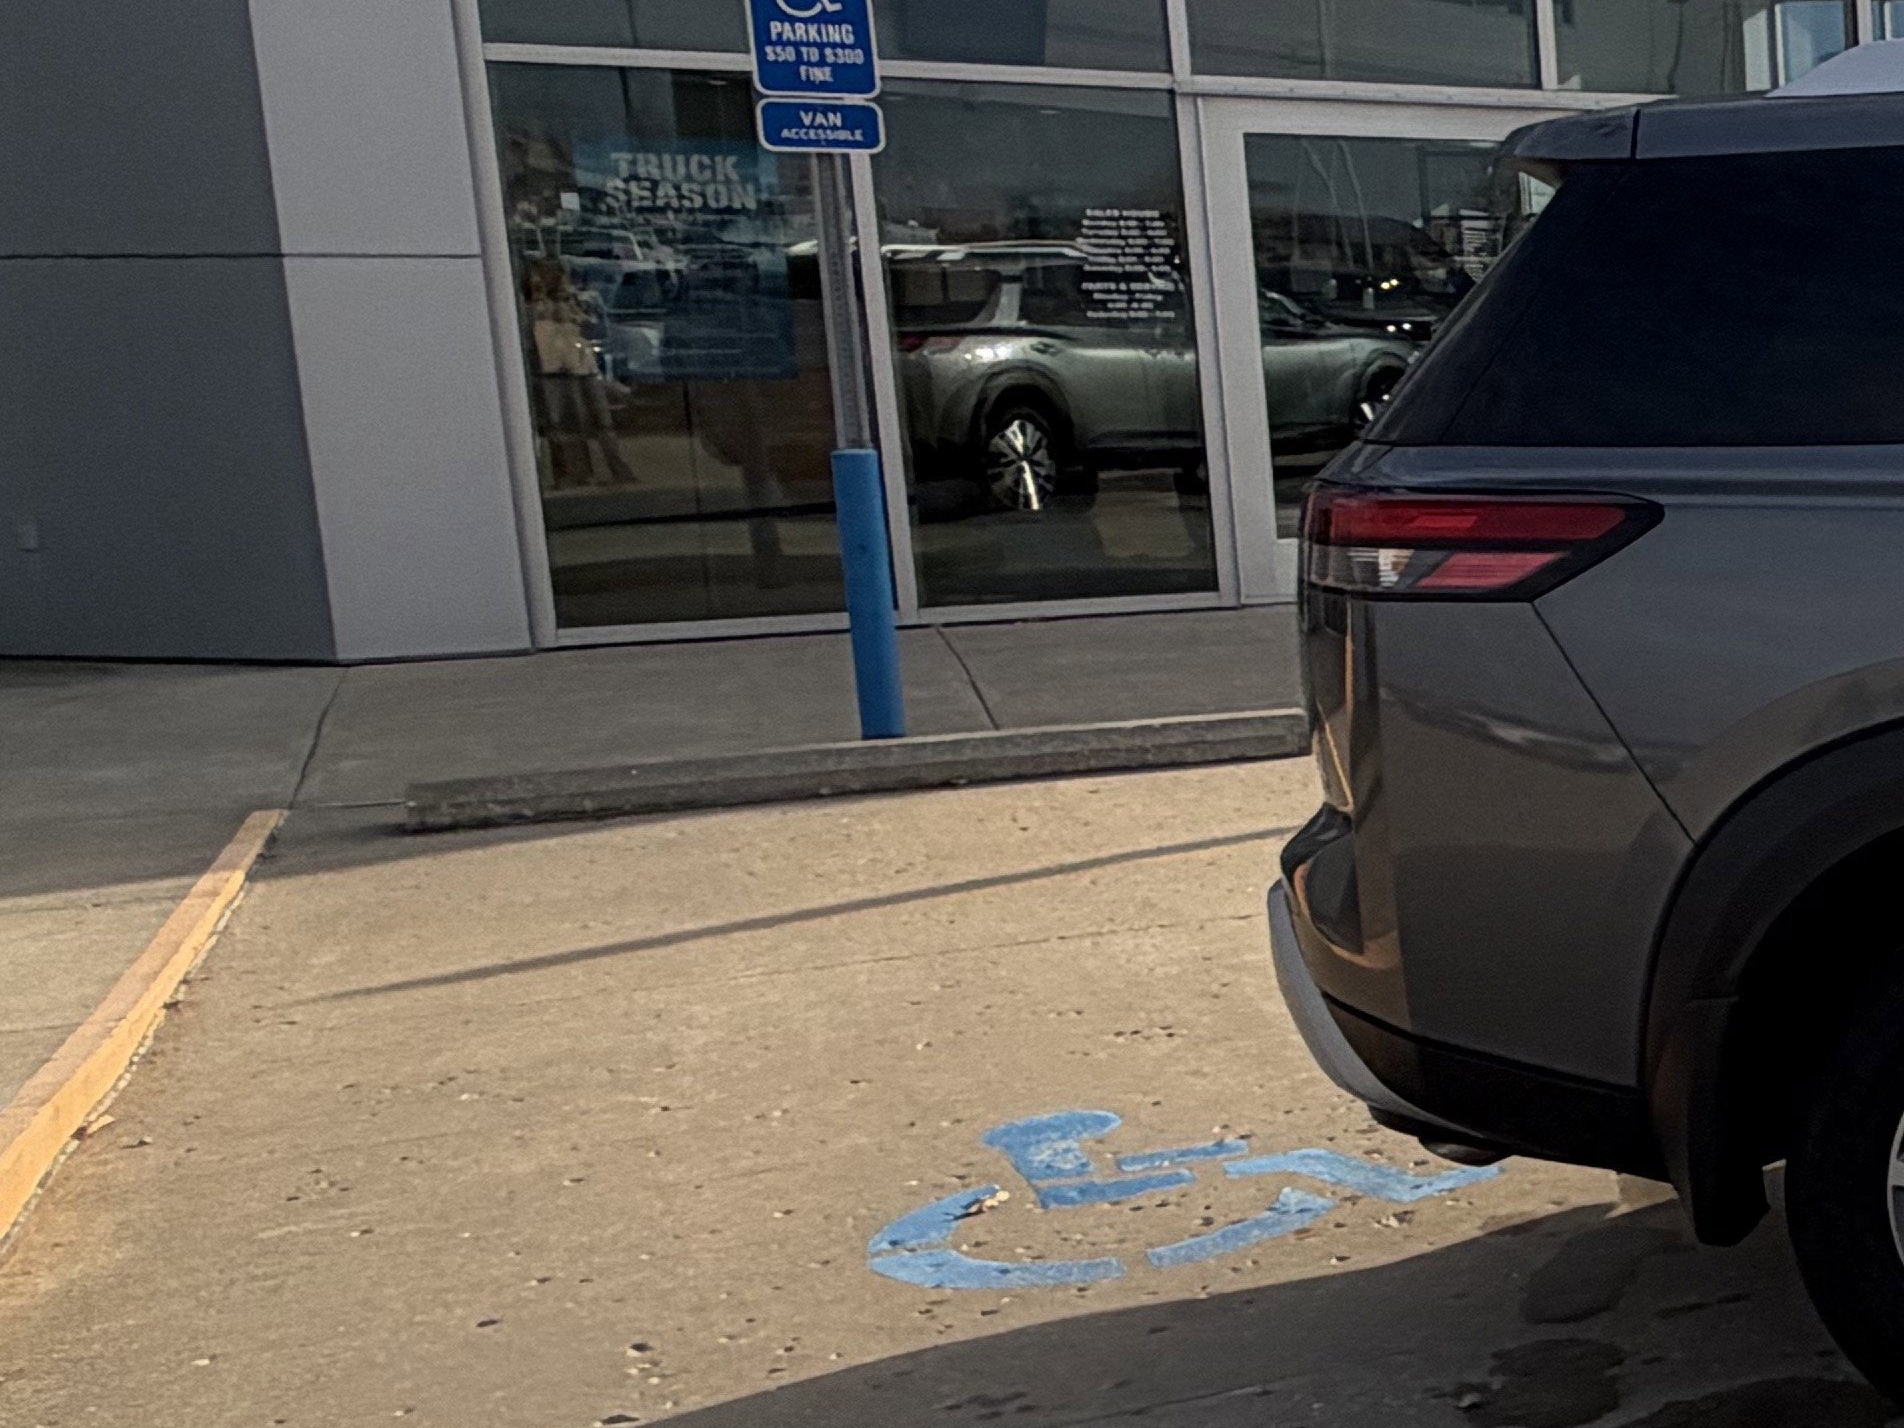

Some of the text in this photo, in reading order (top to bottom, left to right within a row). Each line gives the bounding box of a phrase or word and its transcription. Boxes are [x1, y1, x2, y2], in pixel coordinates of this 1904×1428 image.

[769, 21, 855, 44] PARKING
[765, 45, 864, 64] $50 TO $300
[799, 66, 834, 82] FINE
[799, 110, 842, 127] VAN
[780, 128, 864, 141] ACCESSIBLE
[610, 152, 739, 182] TRUCK
[605, 178, 757, 210] SEASON
